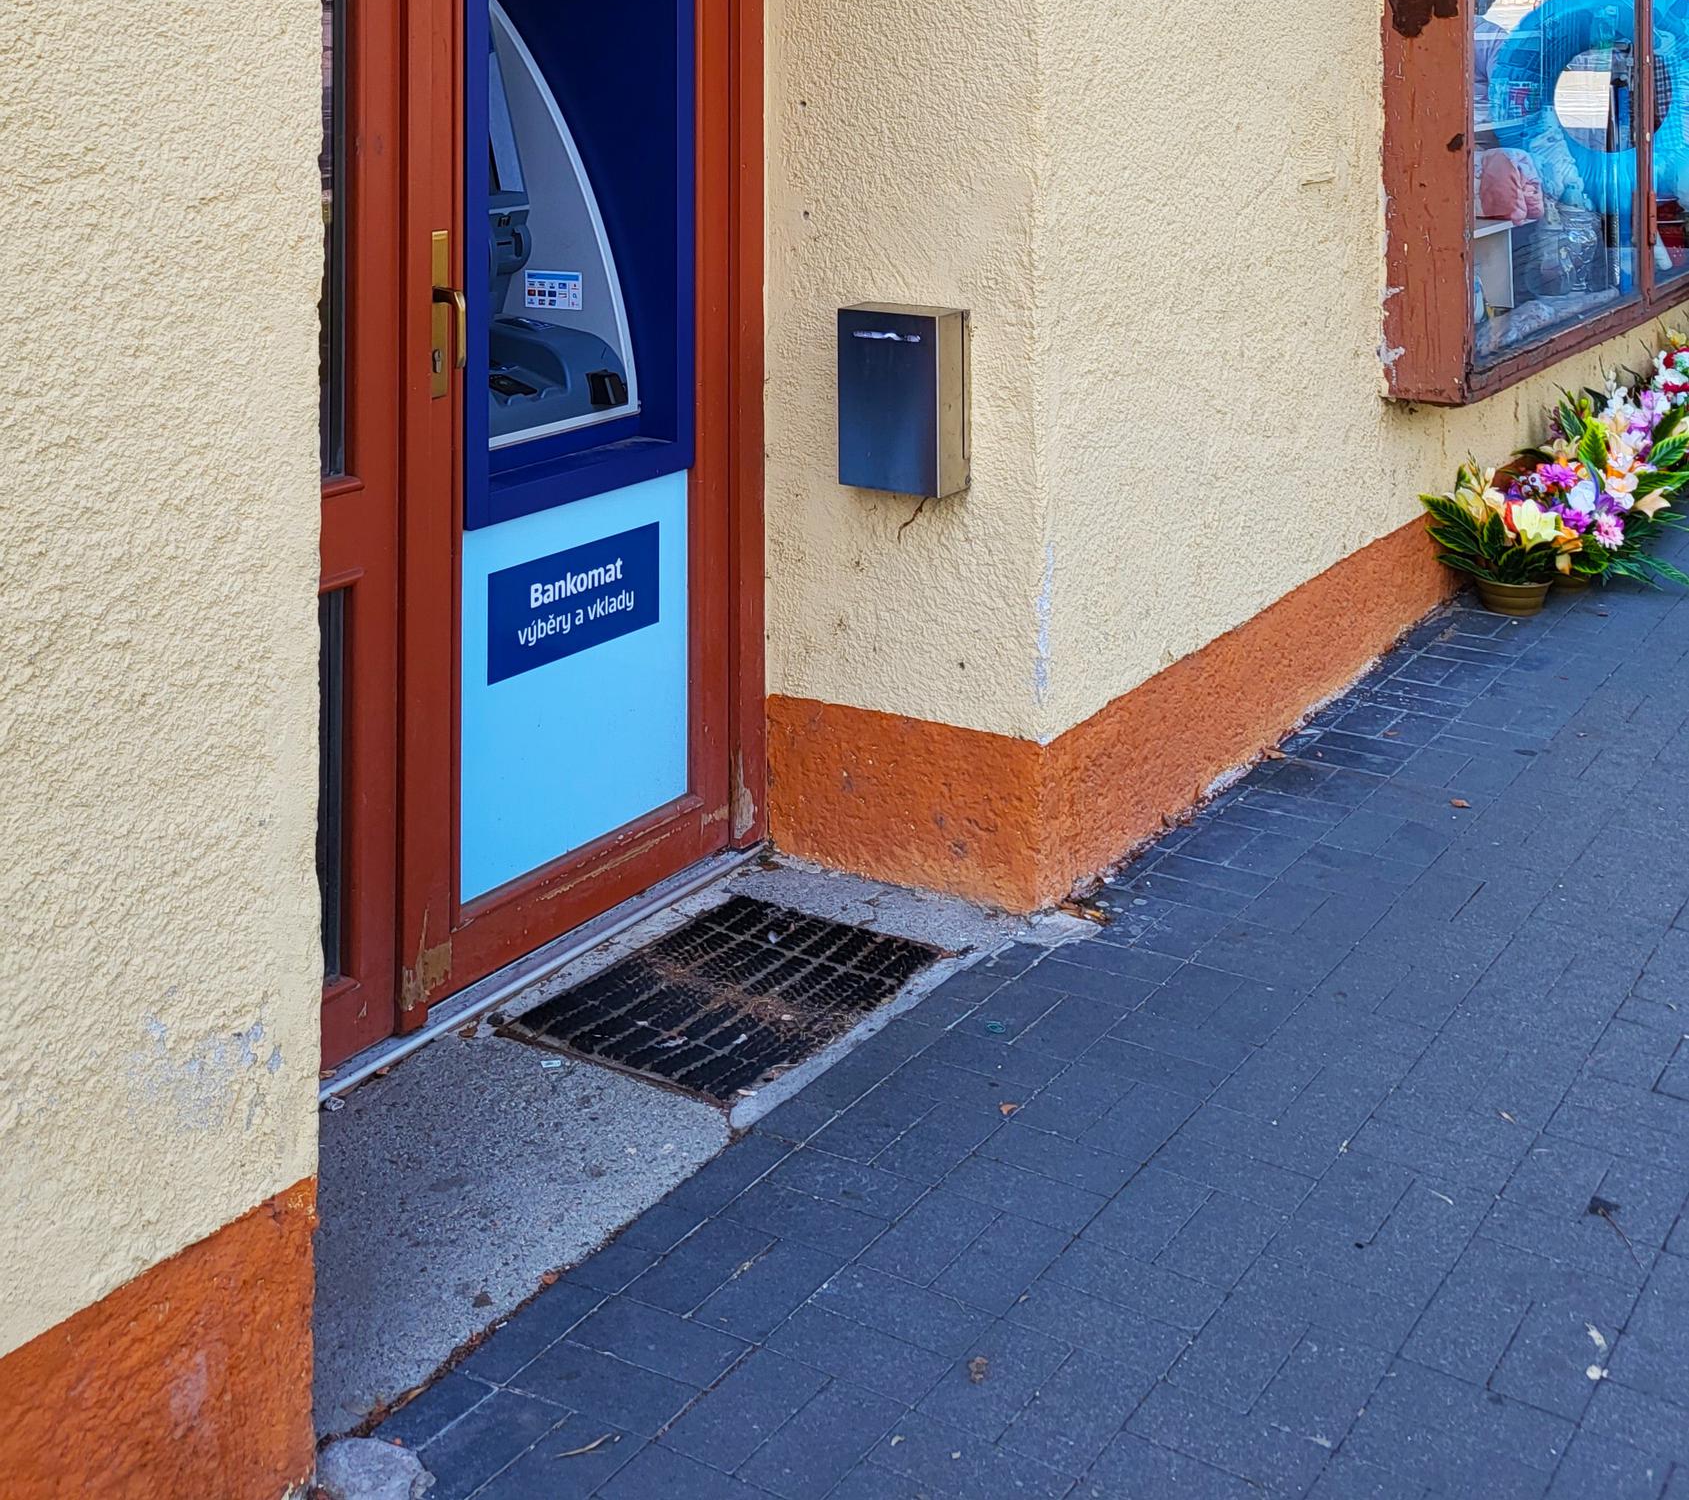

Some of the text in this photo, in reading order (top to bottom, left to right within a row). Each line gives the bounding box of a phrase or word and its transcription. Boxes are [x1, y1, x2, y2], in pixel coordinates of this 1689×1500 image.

[530, 557, 623, 609] Bankomat
[518, 590, 634, 646] výběry a vklady
